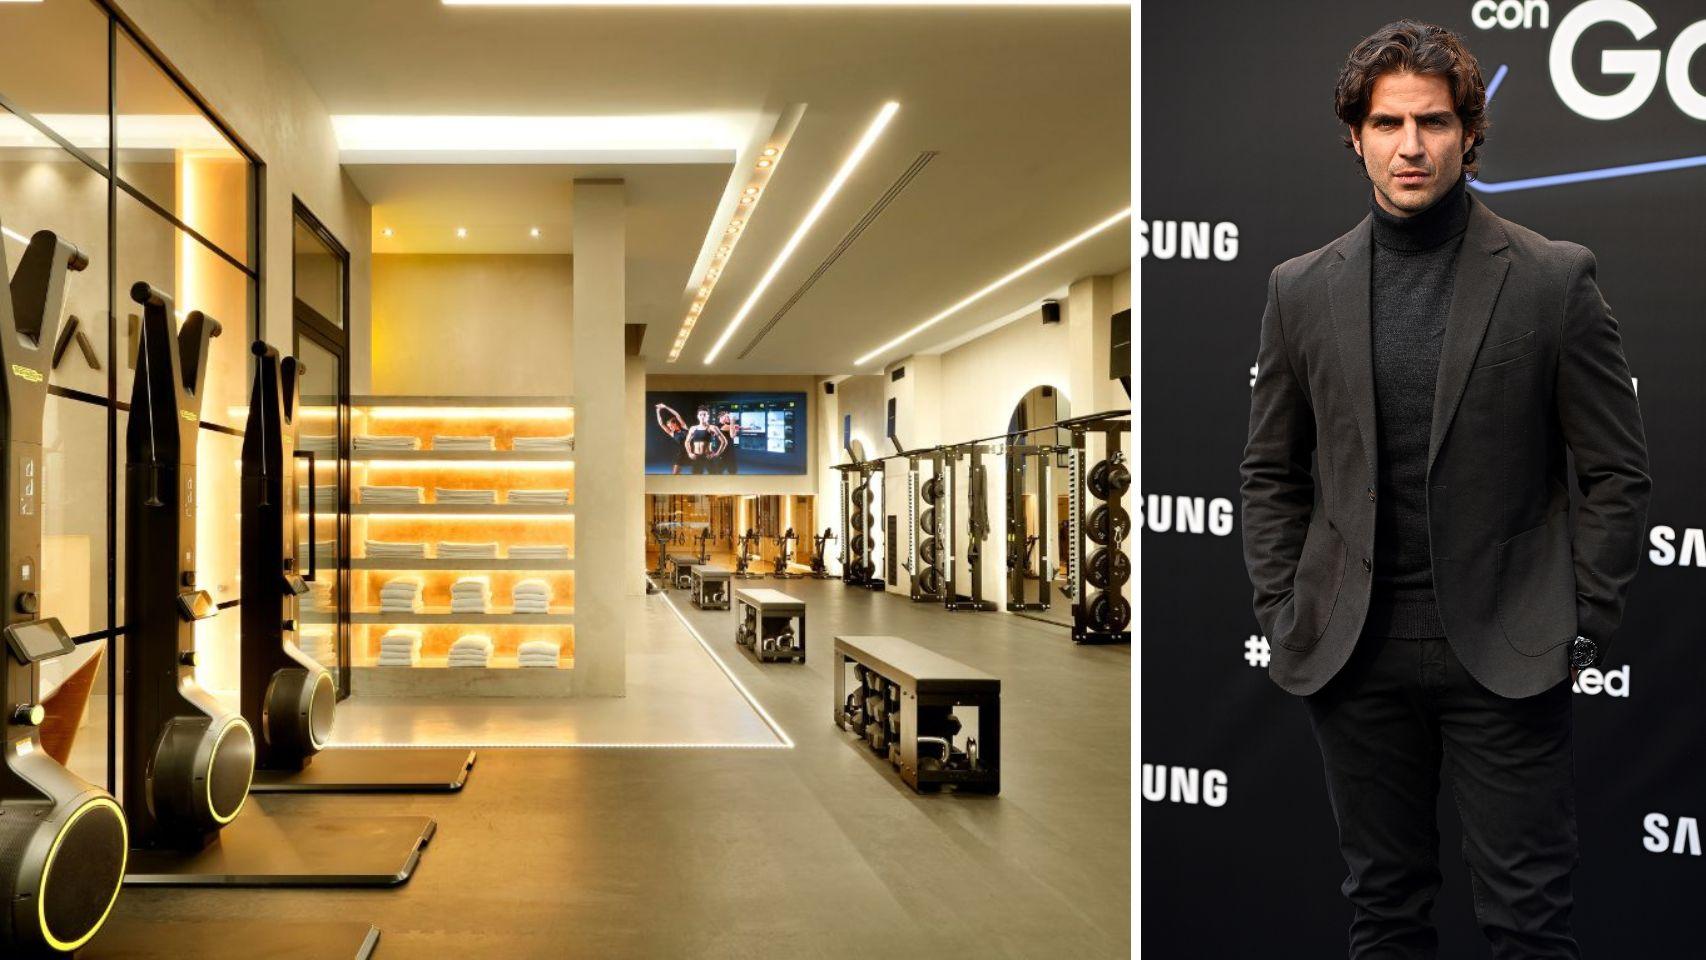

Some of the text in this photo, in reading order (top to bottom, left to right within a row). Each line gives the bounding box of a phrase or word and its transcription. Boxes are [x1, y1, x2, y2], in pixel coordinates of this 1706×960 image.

[1471, 0, 1549, 30] con
[1141, 493, 1234, 537] UNG
[1571, 664, 1631, 698] ed
[1142, 763, 1229, 808] UNG
